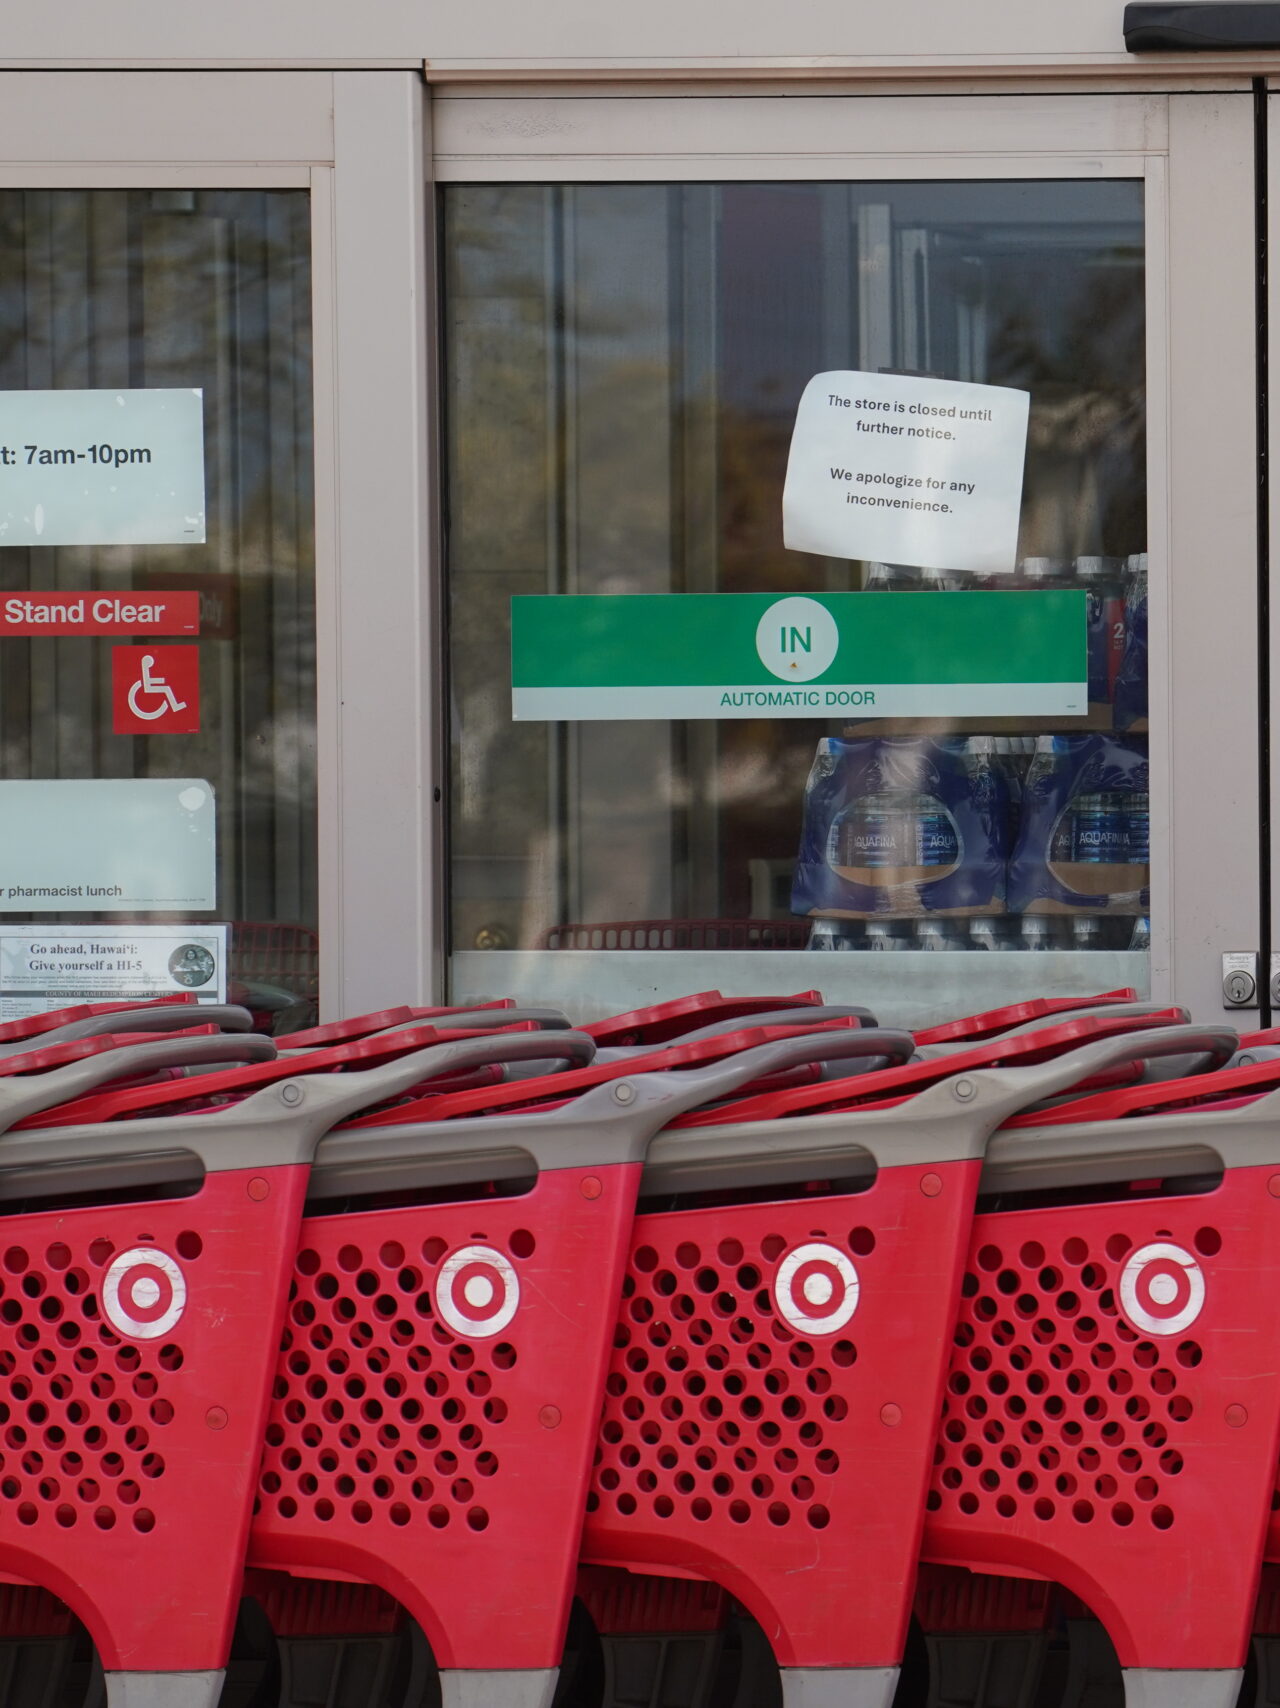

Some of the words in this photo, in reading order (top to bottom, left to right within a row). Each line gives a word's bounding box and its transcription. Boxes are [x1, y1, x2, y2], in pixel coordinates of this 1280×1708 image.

[828, 394, 852, 408] The
[854, 398, 890, 412] store
[893, 400, 905, 412] is
[908, 402, 956, 418] closed
[959, 407, 992, 422] until
[856, 420, 904, 436] further
[907, 425, 956, 441] notice.
[0, 446, 16, 466] t:
[24, 444, 152, 469] 7am-10pm
[830, 467, 853, 481] We
[855, 471, 923, 490] apologize
[926, 476, 947, 490] for
[949, 481, 976, 496] any
[846, 491, 953, 514] inconvenience.
[5, 599, 84, 623] Stand
[92, 598, 165, 623] Clear
[780, 626, 812, 653] IN
[720, 691, 820, 707] AUTOMATIC
[825, 690, 876, 706] DOOR
[8, 885, 83, 900] pharmacist
[86, 884, 122, 897] lunch
[30, 943, 47, 954] Go
[50, 943, 87, 956] ahead,
[29, 960, 55, 971] Give
[58, 960, 104, 974] yourself
[107, 963, 113, 971] a
[116, 960, 142, 971] HI-5
[45, 990, 72, 998] COUNTY
